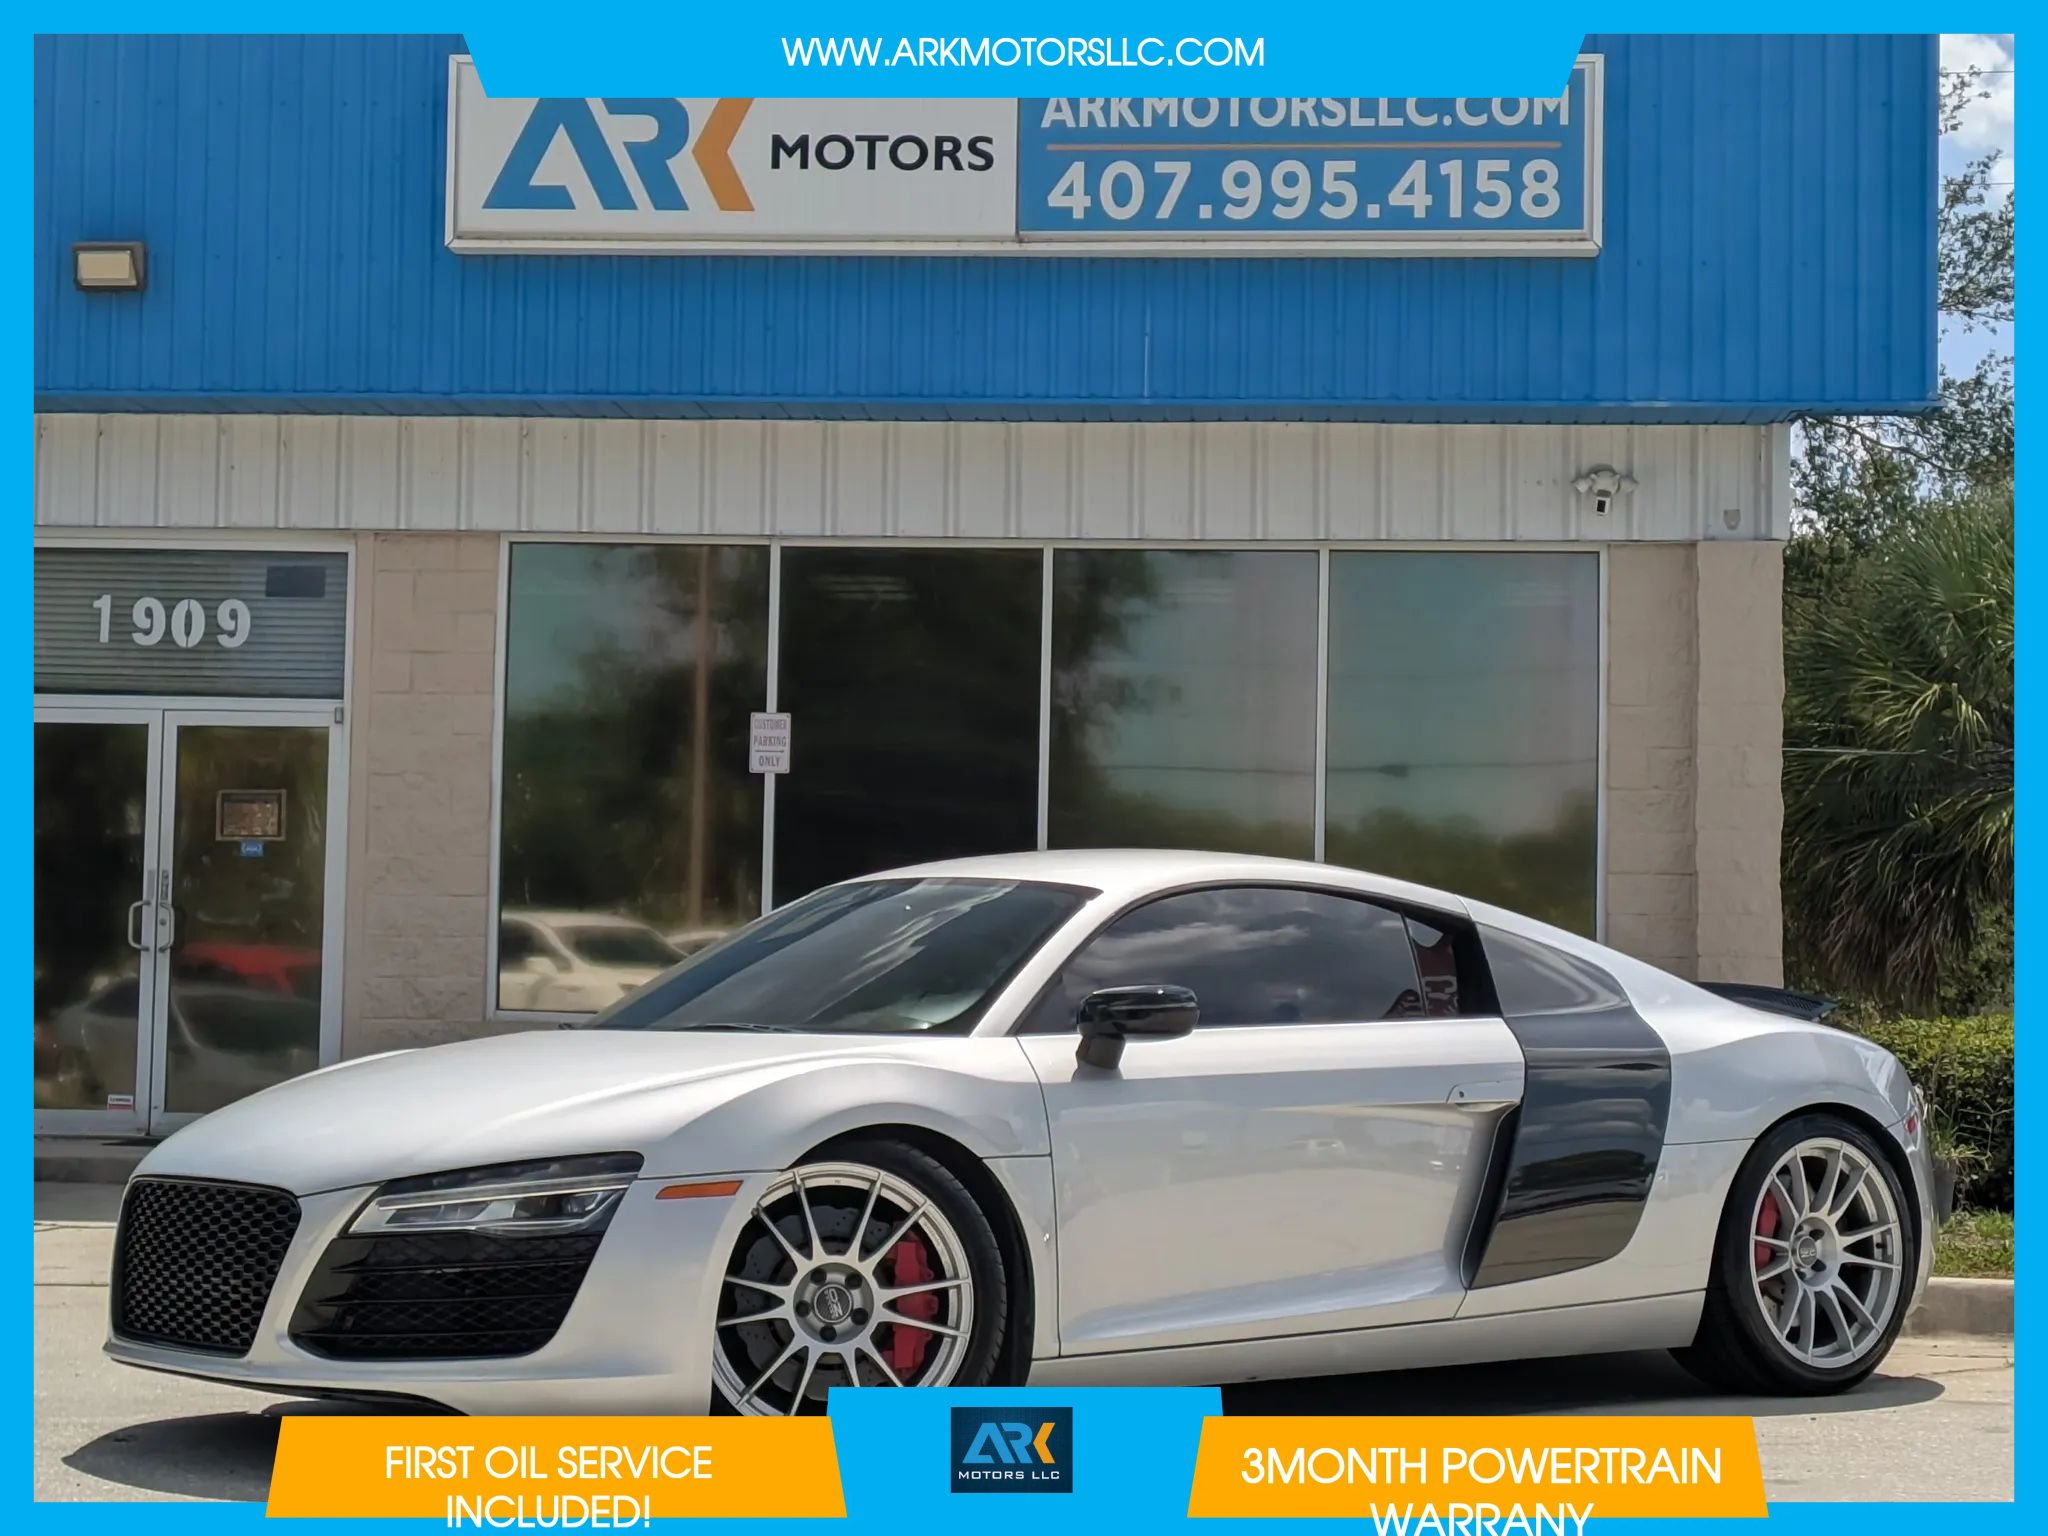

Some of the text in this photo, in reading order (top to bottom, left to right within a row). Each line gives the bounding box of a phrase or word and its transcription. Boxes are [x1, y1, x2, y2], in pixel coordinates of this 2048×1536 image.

[1040, 96, 1569, 128] ARKMOTORSLLC.COM
[481, 97, 994, 211] ARK MOTORS
[1047, 159, 1560, 220] 407.995.4158
[93, 594, 250, 648] 1909
[753, 735, 787, 747] PARKING
[758, 755, 781, 768] ONLY
